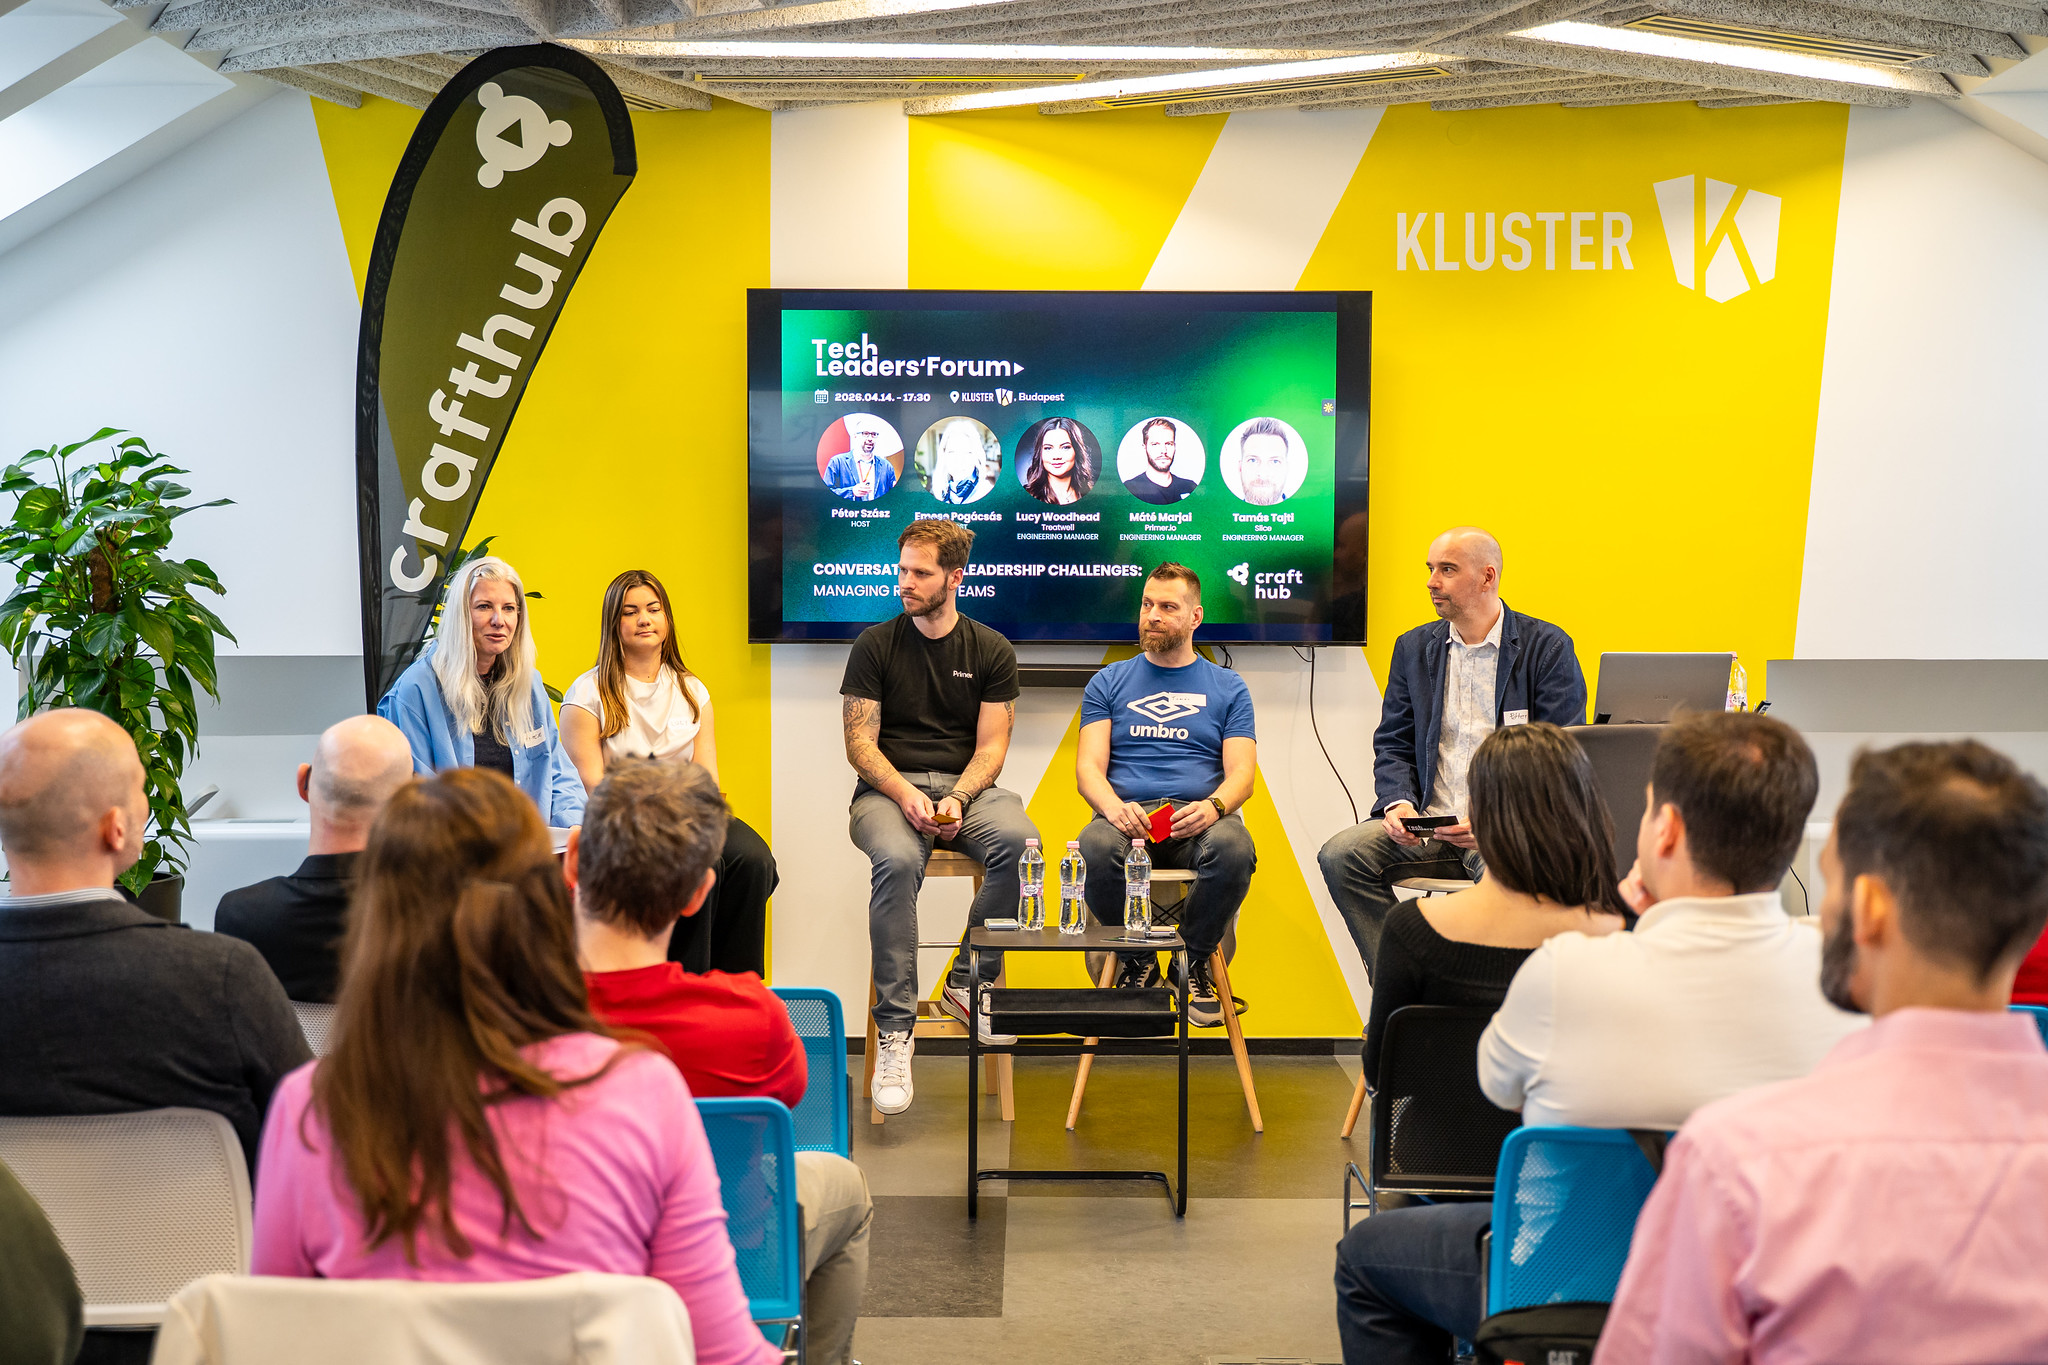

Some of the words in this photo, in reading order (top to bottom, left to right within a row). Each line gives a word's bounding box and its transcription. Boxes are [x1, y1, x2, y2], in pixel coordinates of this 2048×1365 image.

[1397, 212, 1634, 271] KLUSTER
[811, 333, 878, 359] Tech
[389, 197, 587, 593] crafthub
[835, 393, 895, 402] 2026.04.14.
[903, 393, 931, 402] 17:30
[961, 392, 994, 402] KLUSTER
[1019, 392, 1065, 404] Budapest
[831, 508, 860, 518] Péter
[860, 508, 891, 518] Szász
[951, 511, 1002, 523] Pogácsás
[1016, 512, 1041, 524] Lucy
[1042, 512, 1100, 522] Woodhead
[1129, 512, 1157, 522] Máté
[1232, 512, 1269, 522] Tamás
[1270, 512, 1295, 525] Tajti
[850, 520, 870, 528] HOST
[1041, 523, 1075, 531] Treatwell
[1119, 533, 1165, 541] ENGINEERING
[1166, 533, 1202, 541] MANAGER
[813, 563, 900, 576] CONVERSAT
[962, 564, 1046, 576] LEADERSHIP
[1047, 564, 1143, 577] CHALLENGES:
[1254, 569, 1303, 584] craft
[813, 584, 890, 597] MANAGING
[957, 585, 996, 598] EAMS
[1254, 584, 1291, 599] hub
[1129, 723, 1189, 740] umbro
